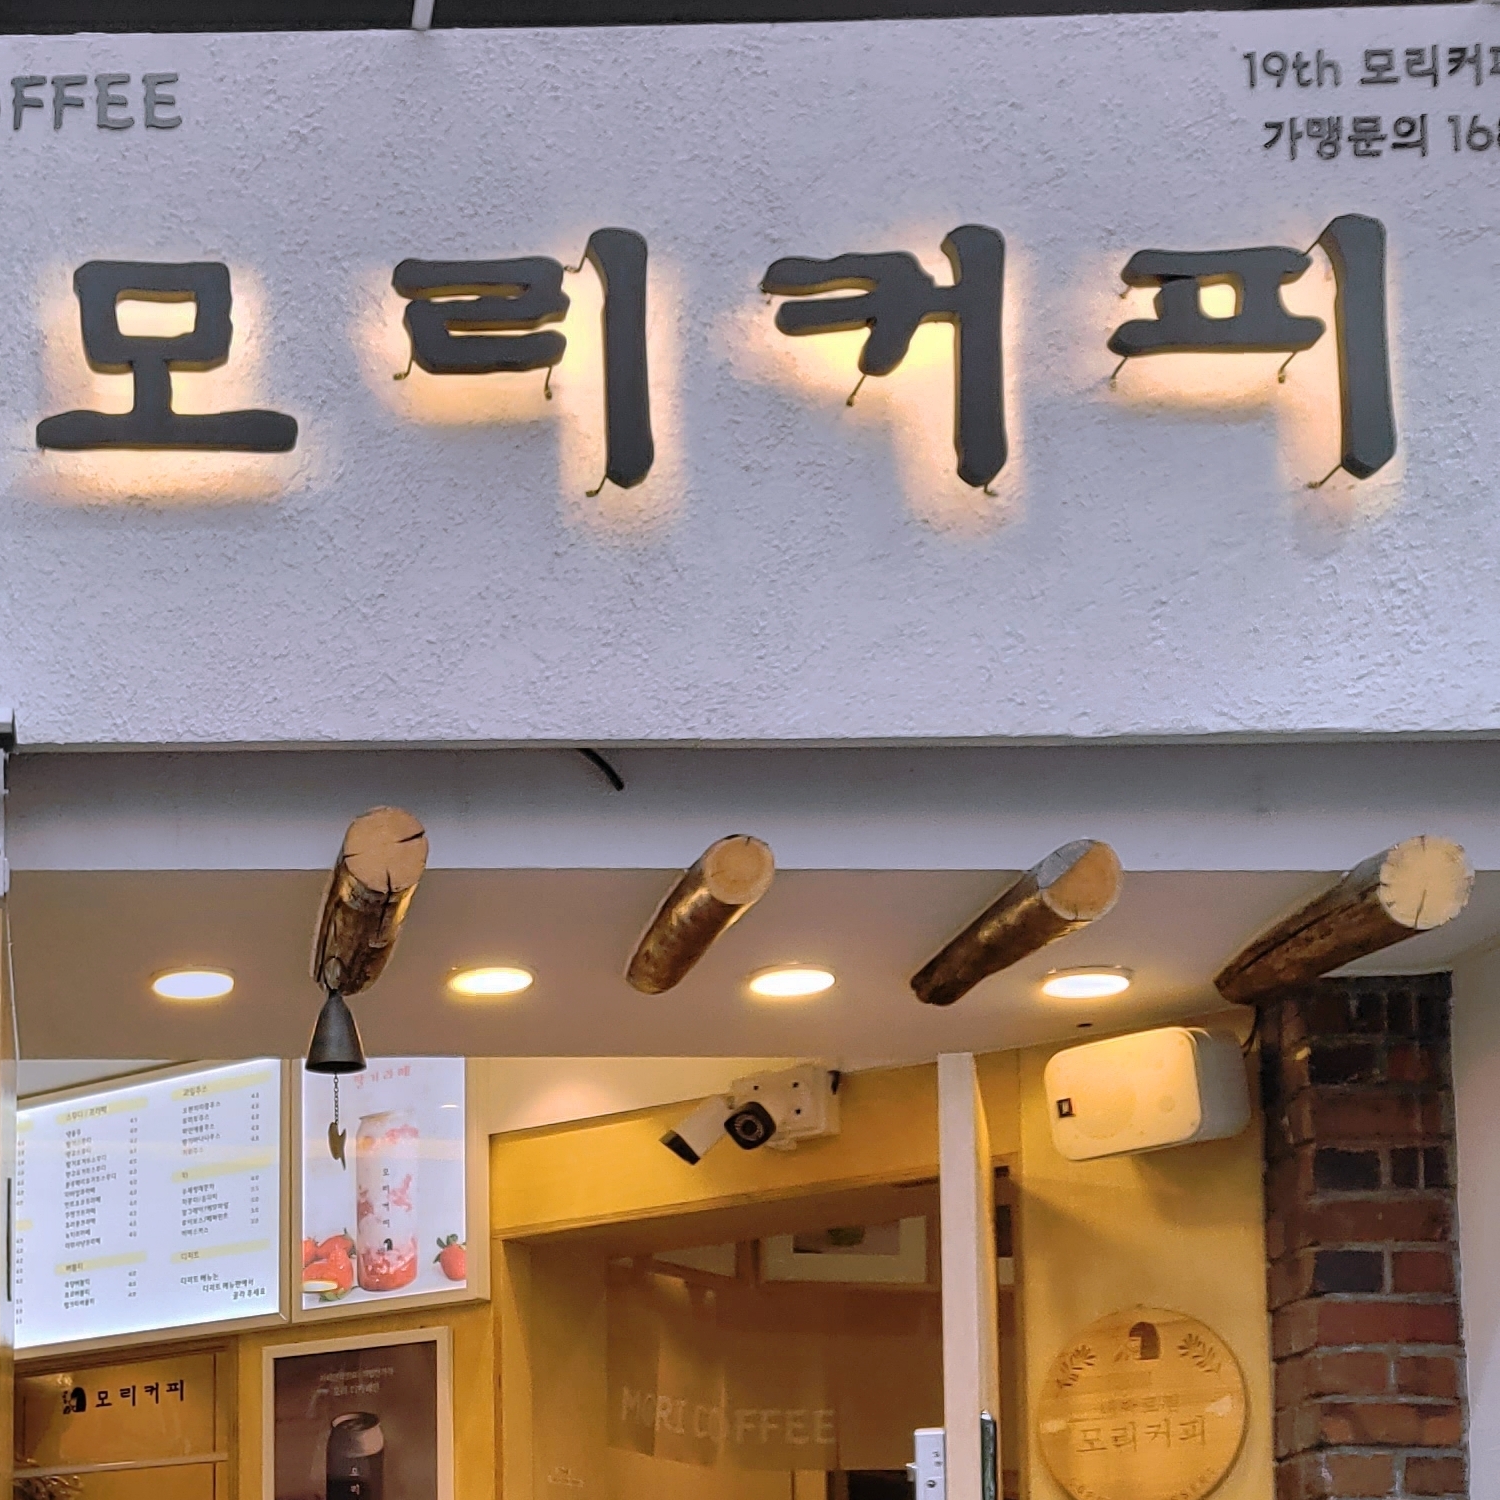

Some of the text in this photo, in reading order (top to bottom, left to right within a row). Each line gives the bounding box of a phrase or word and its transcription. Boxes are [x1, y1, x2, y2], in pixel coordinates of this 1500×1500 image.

[1243, 49, 1341, 87] 19th
[1262, 113, 1500, 160] 가맹문의 16
[36, 213, 1396, 488] 모리커피
[96, 1379, 185, 1408] 모리커피
[1075, 1415, 1207, 1453] 모리커피
